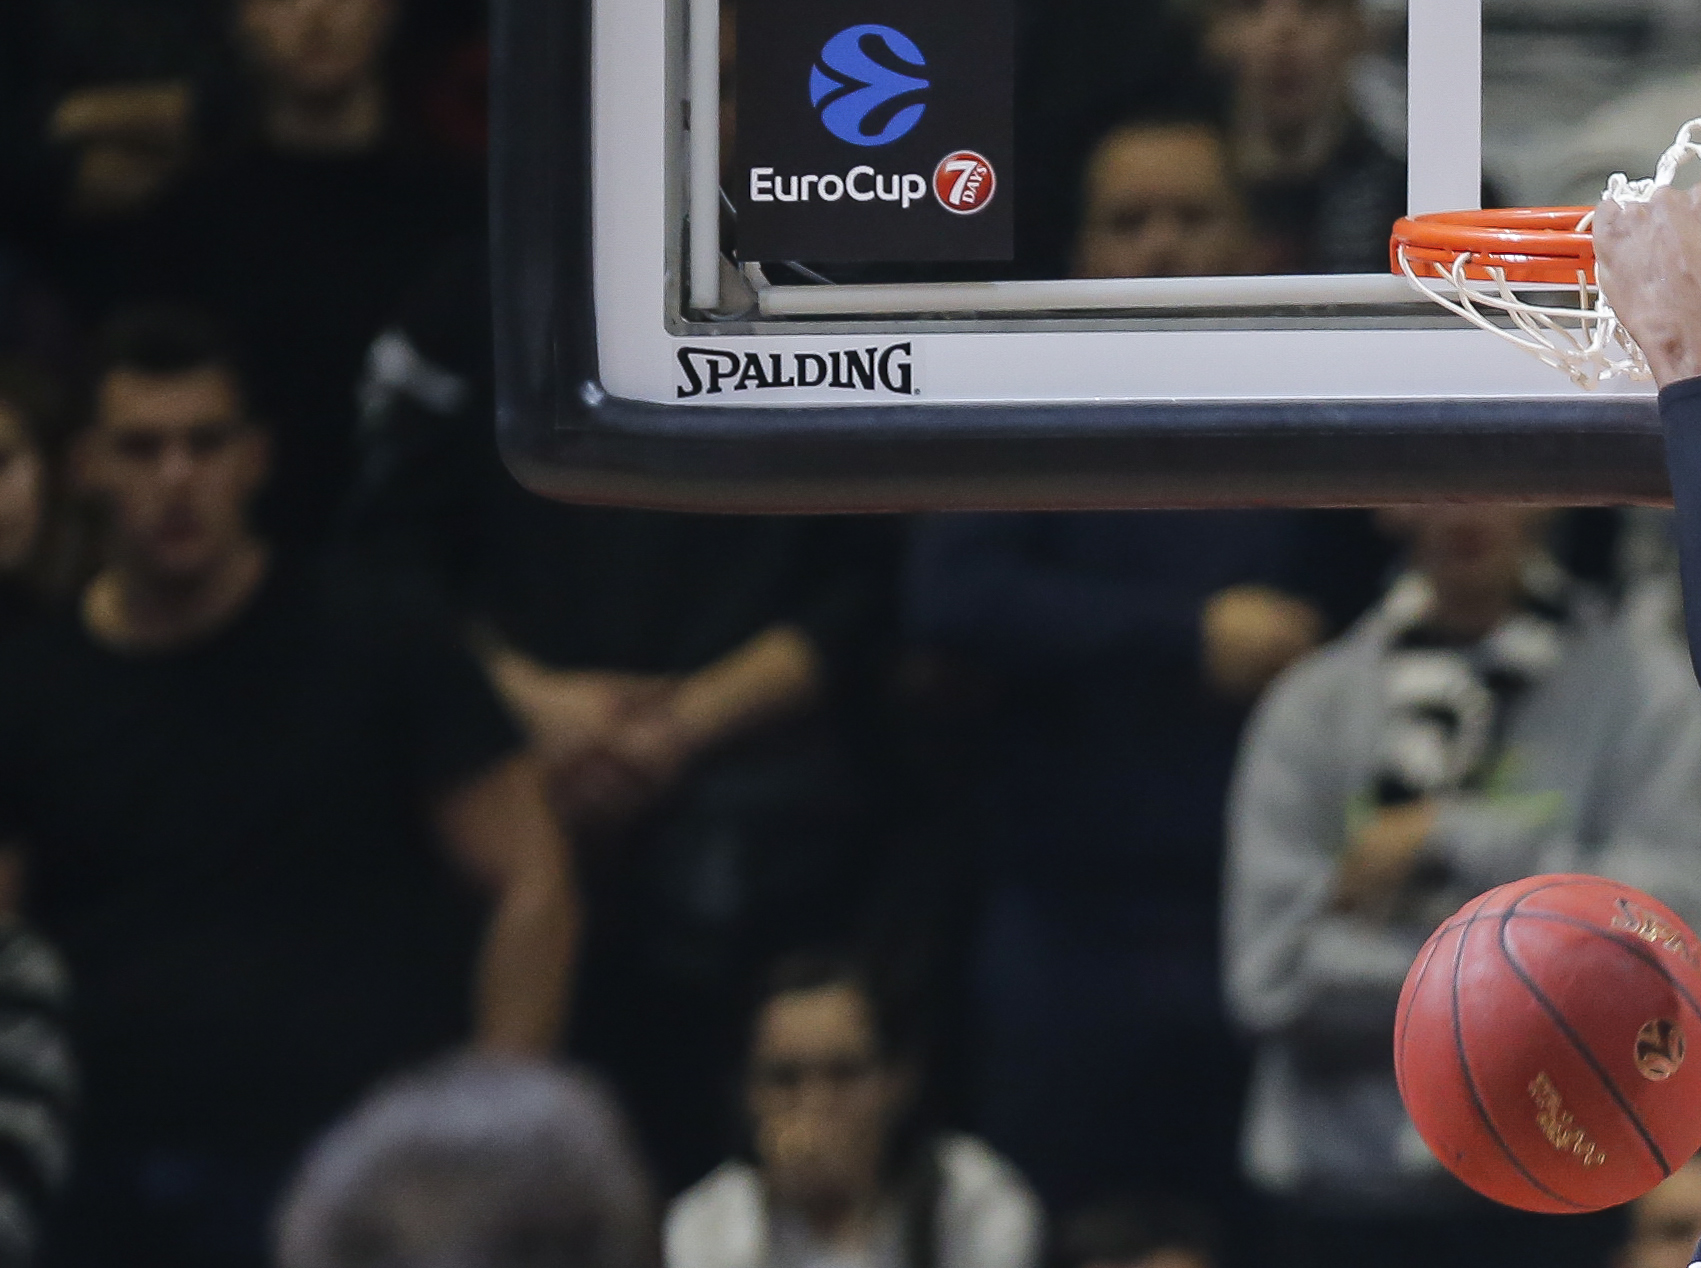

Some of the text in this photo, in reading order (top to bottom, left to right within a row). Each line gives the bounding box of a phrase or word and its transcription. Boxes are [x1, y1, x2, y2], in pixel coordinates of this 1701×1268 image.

[749, 165, 927, 209] EuroCup
[944, 158, 989, 206] 7 DAYS
[676, 341, 915, 399] SPALDING
